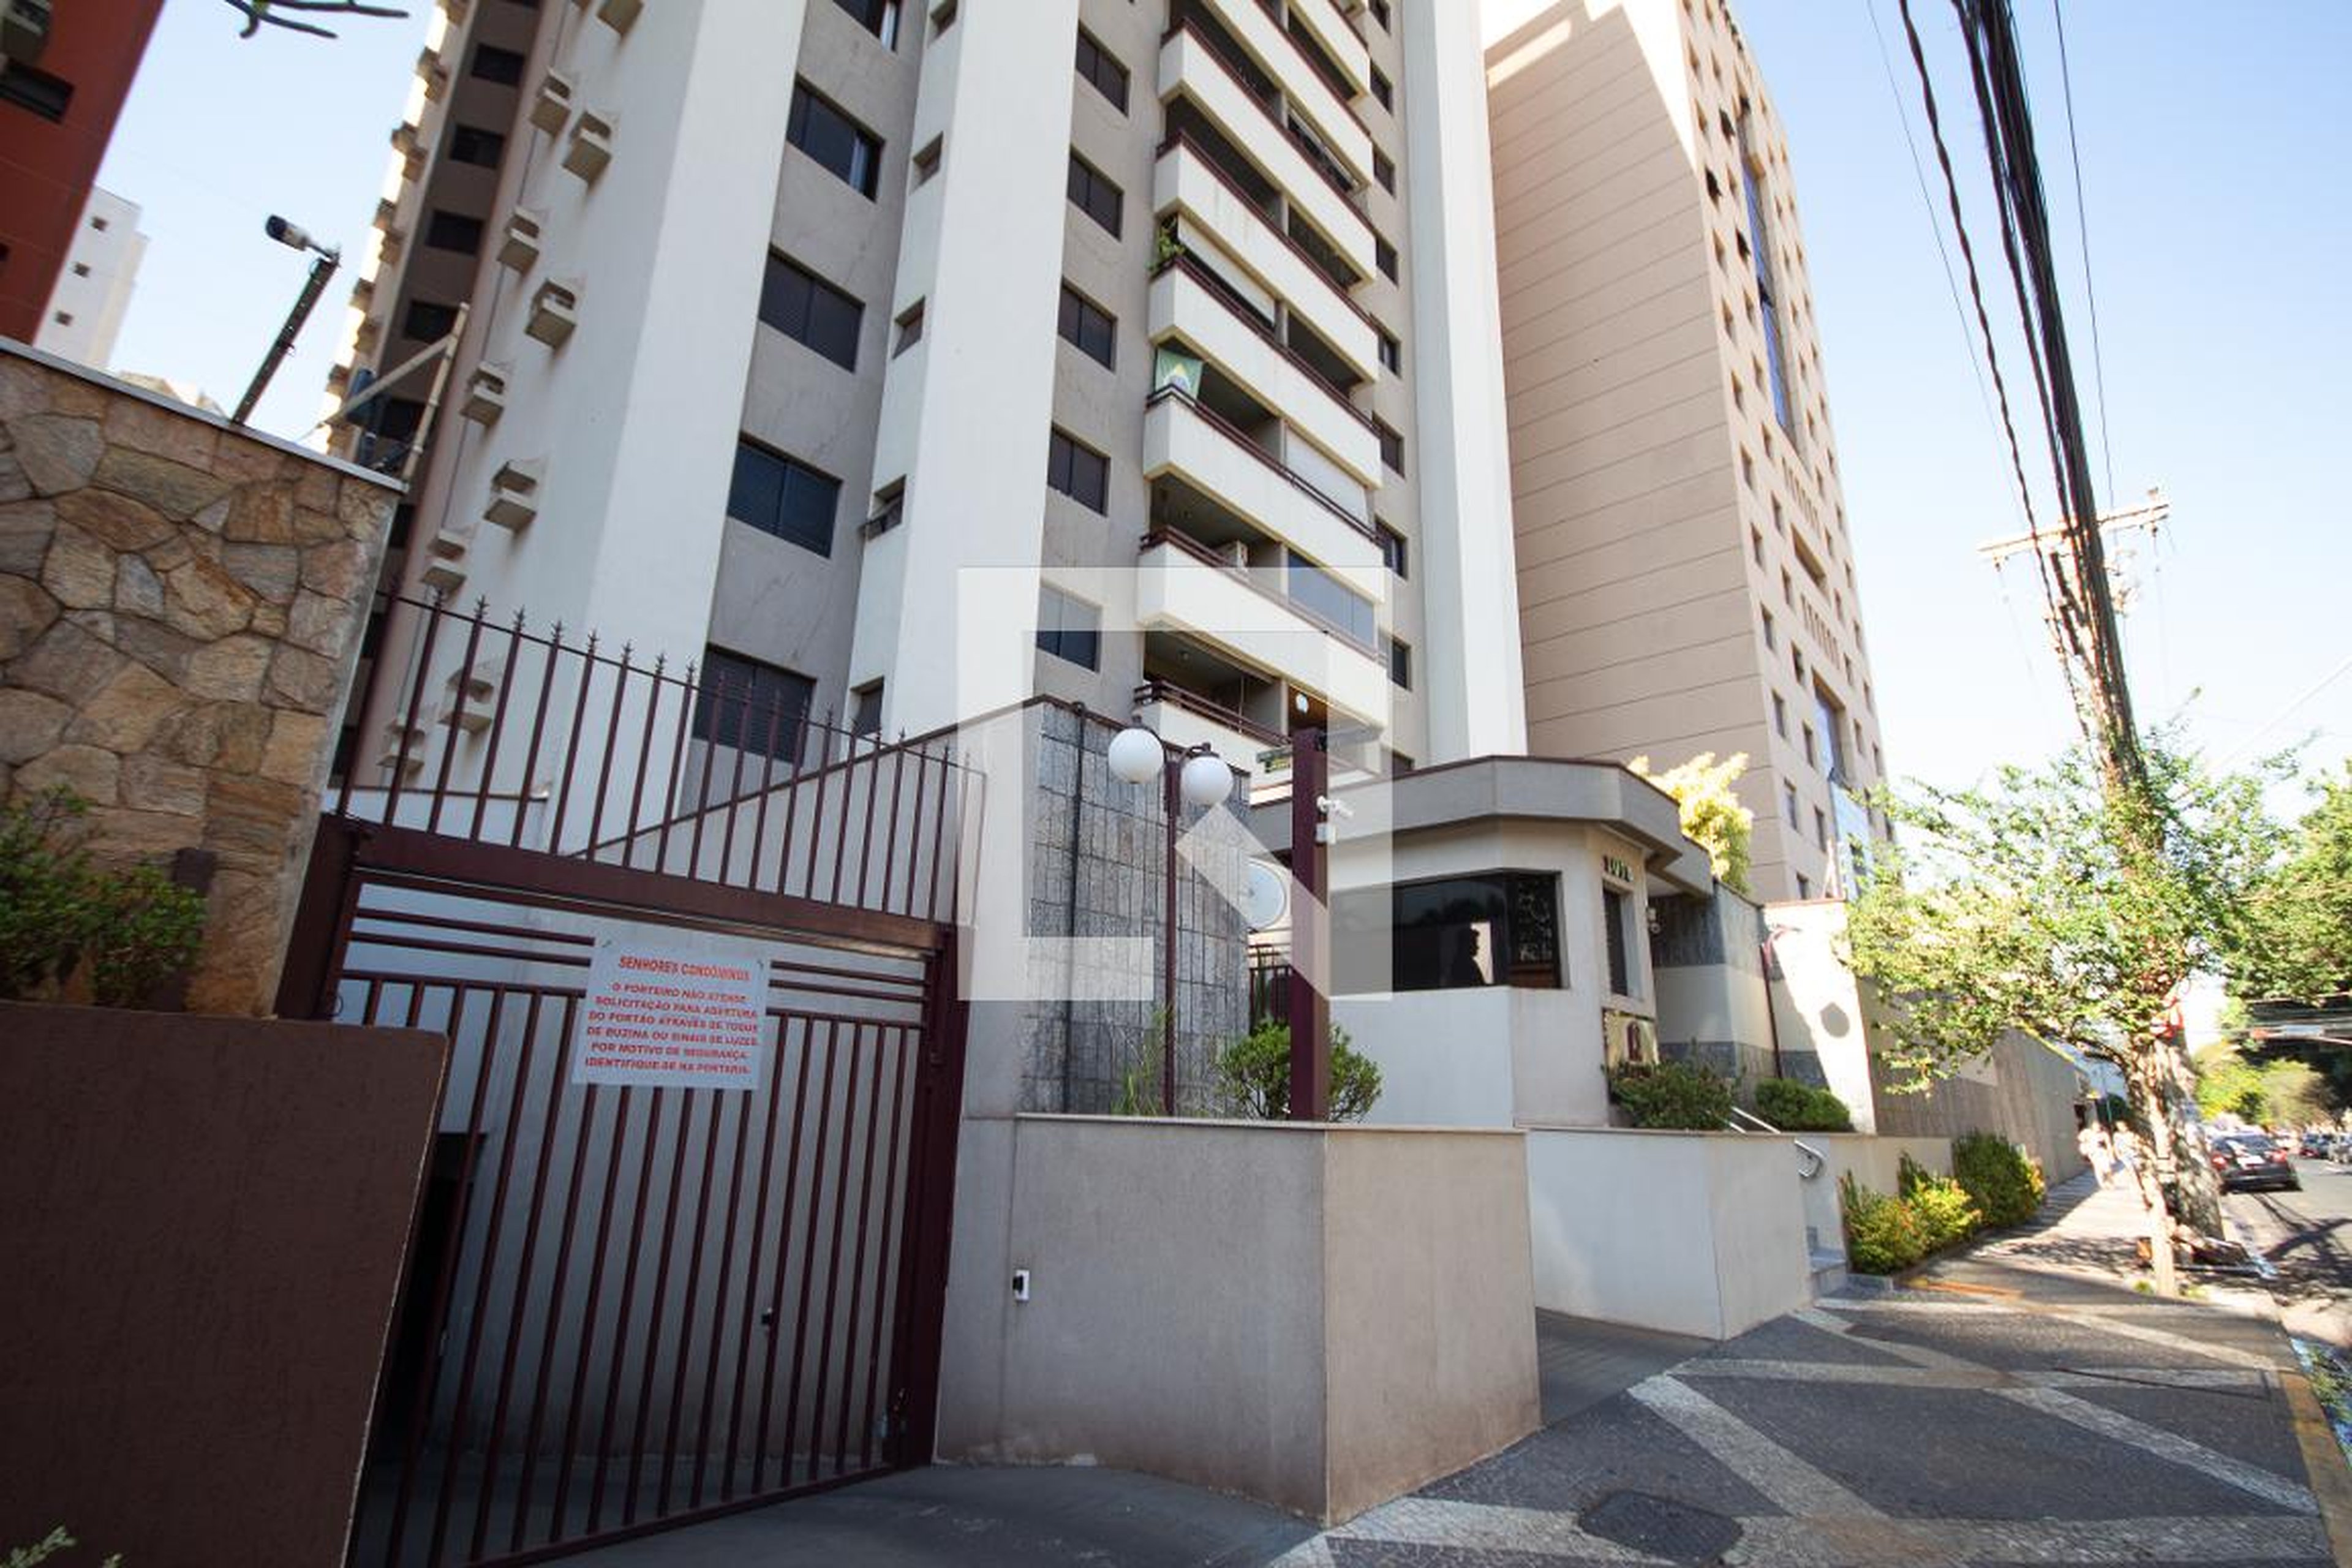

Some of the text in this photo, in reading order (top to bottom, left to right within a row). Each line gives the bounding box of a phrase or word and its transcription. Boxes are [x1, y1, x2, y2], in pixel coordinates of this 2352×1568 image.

[619, 956, 678, 973] SENHORES
[612, 982, 621, 991] O
[624, 984, 680, 997] PORTEIRO
[596, 996, 670, 1010] SOLICITAÇÃO
[589, 1011, 605, 1020] DO
[588, 1027, 601, 1036] DE
[606, 1027, 649, 1039] BUZINA
[652, 1031, 668, 1040] OU
[592, 1042, 616, 1052] POR
[619, 1044, 663, 1055] MOTIVO
